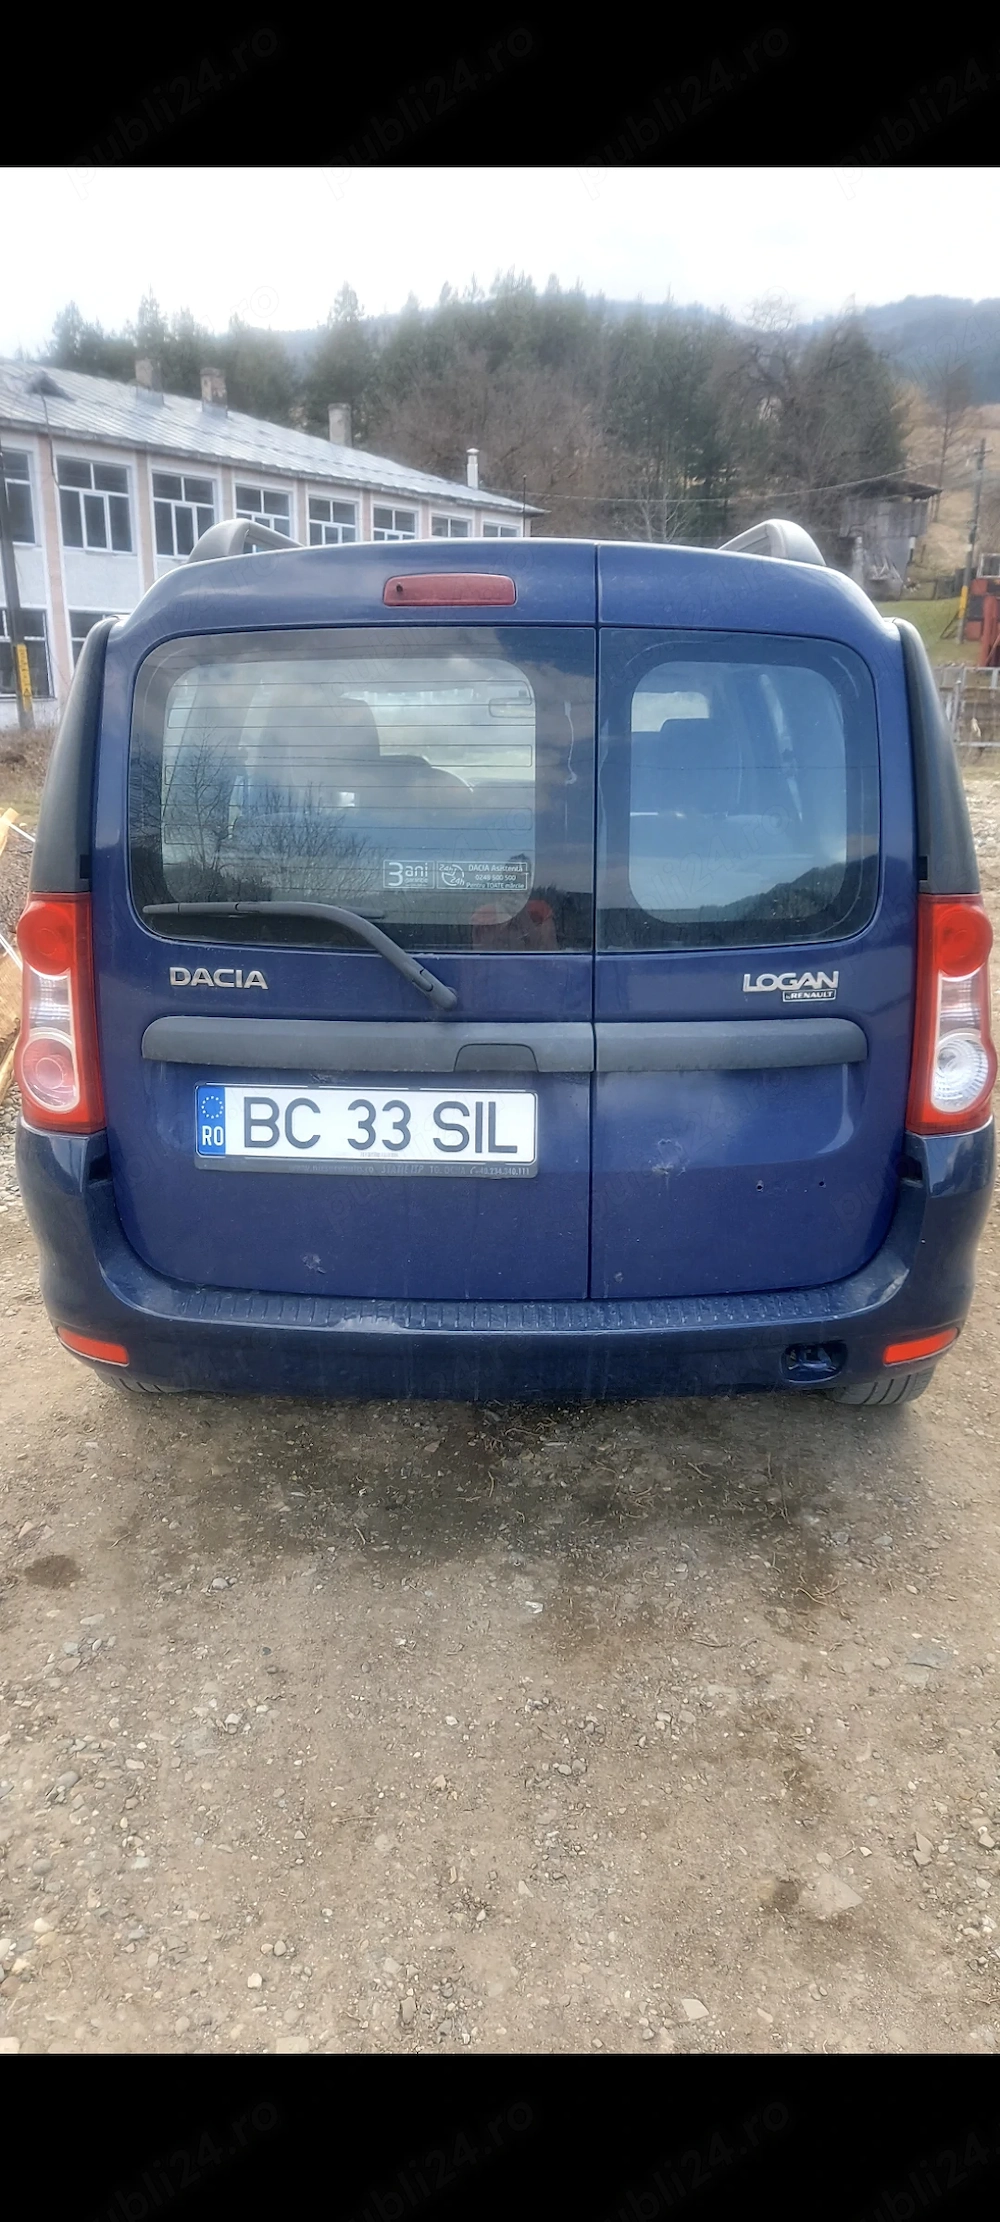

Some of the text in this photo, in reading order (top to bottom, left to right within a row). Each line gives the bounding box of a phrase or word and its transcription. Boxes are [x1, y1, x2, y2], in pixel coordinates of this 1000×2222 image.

[388, 862, 428, 886] 3 ani
[468, 864, 490, 872] DACIA
[169, 966, 269, 990] DACIA
[743, 971, 839, 992] LOGAN
[790, 991, 833, 999] RENAULT
[202, 1125, 224, 1146] RO
[243, 1096, 518, 1154] BC 33 SIL
